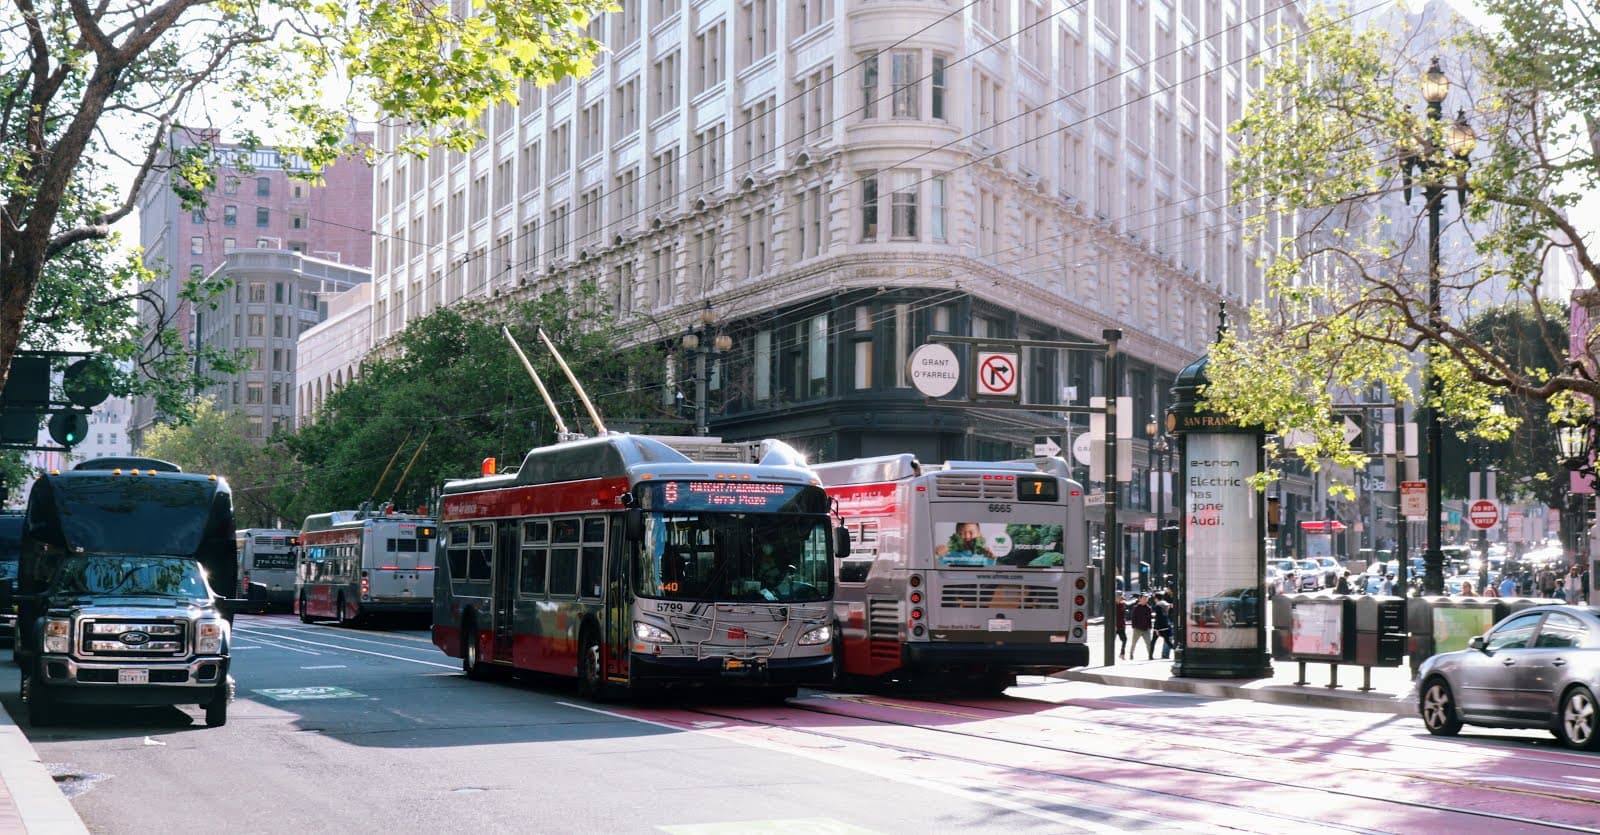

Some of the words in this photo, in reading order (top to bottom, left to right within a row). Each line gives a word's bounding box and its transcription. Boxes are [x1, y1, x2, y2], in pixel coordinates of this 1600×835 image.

[921, 358, 949, 367] GRANT
[913, 370, 956, 380] O'FARRELL
[1184, 416, 1200, 426] SAN
[1190, 476, 1241, 487] Electric
[665, 482, 678, 504] 6
[1033, 482, 1042, 494] 7
[1190, 489, 1212, 499] has
[988, 504, 1012, 513] 6665
[1191, 503, 1224, 512] gone
[1475, 517, 1494, 525] ENTER
[657, 602, 683, 613] 5799
[125, 633, 142, 642] Ford
